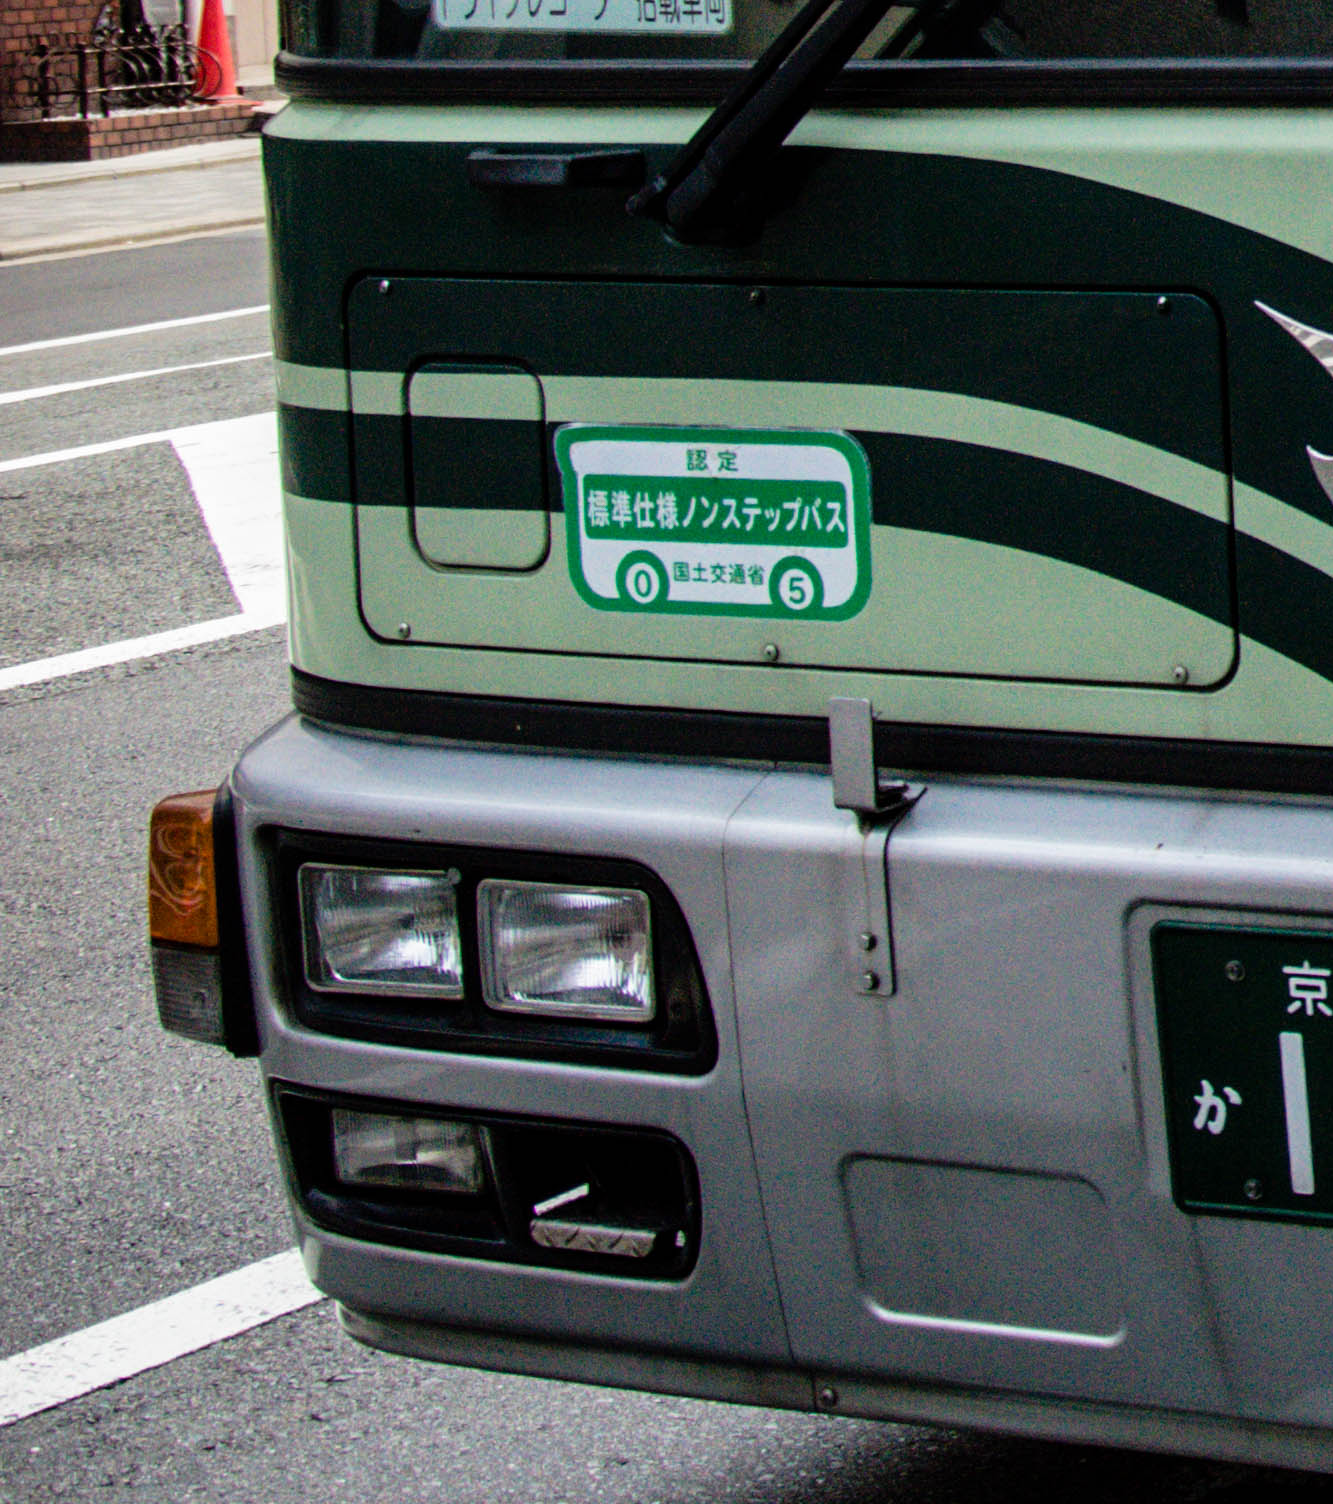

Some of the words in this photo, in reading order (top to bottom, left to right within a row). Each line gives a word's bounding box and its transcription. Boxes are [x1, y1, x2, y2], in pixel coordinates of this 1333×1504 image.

[685, 449, 739, 472] 認定
[587, 489, 846, 534] 標準仕様ノンステップバス
[672, 561, 765, 586] 国土交通省
[1193, 1078, 1243, 1136] か
